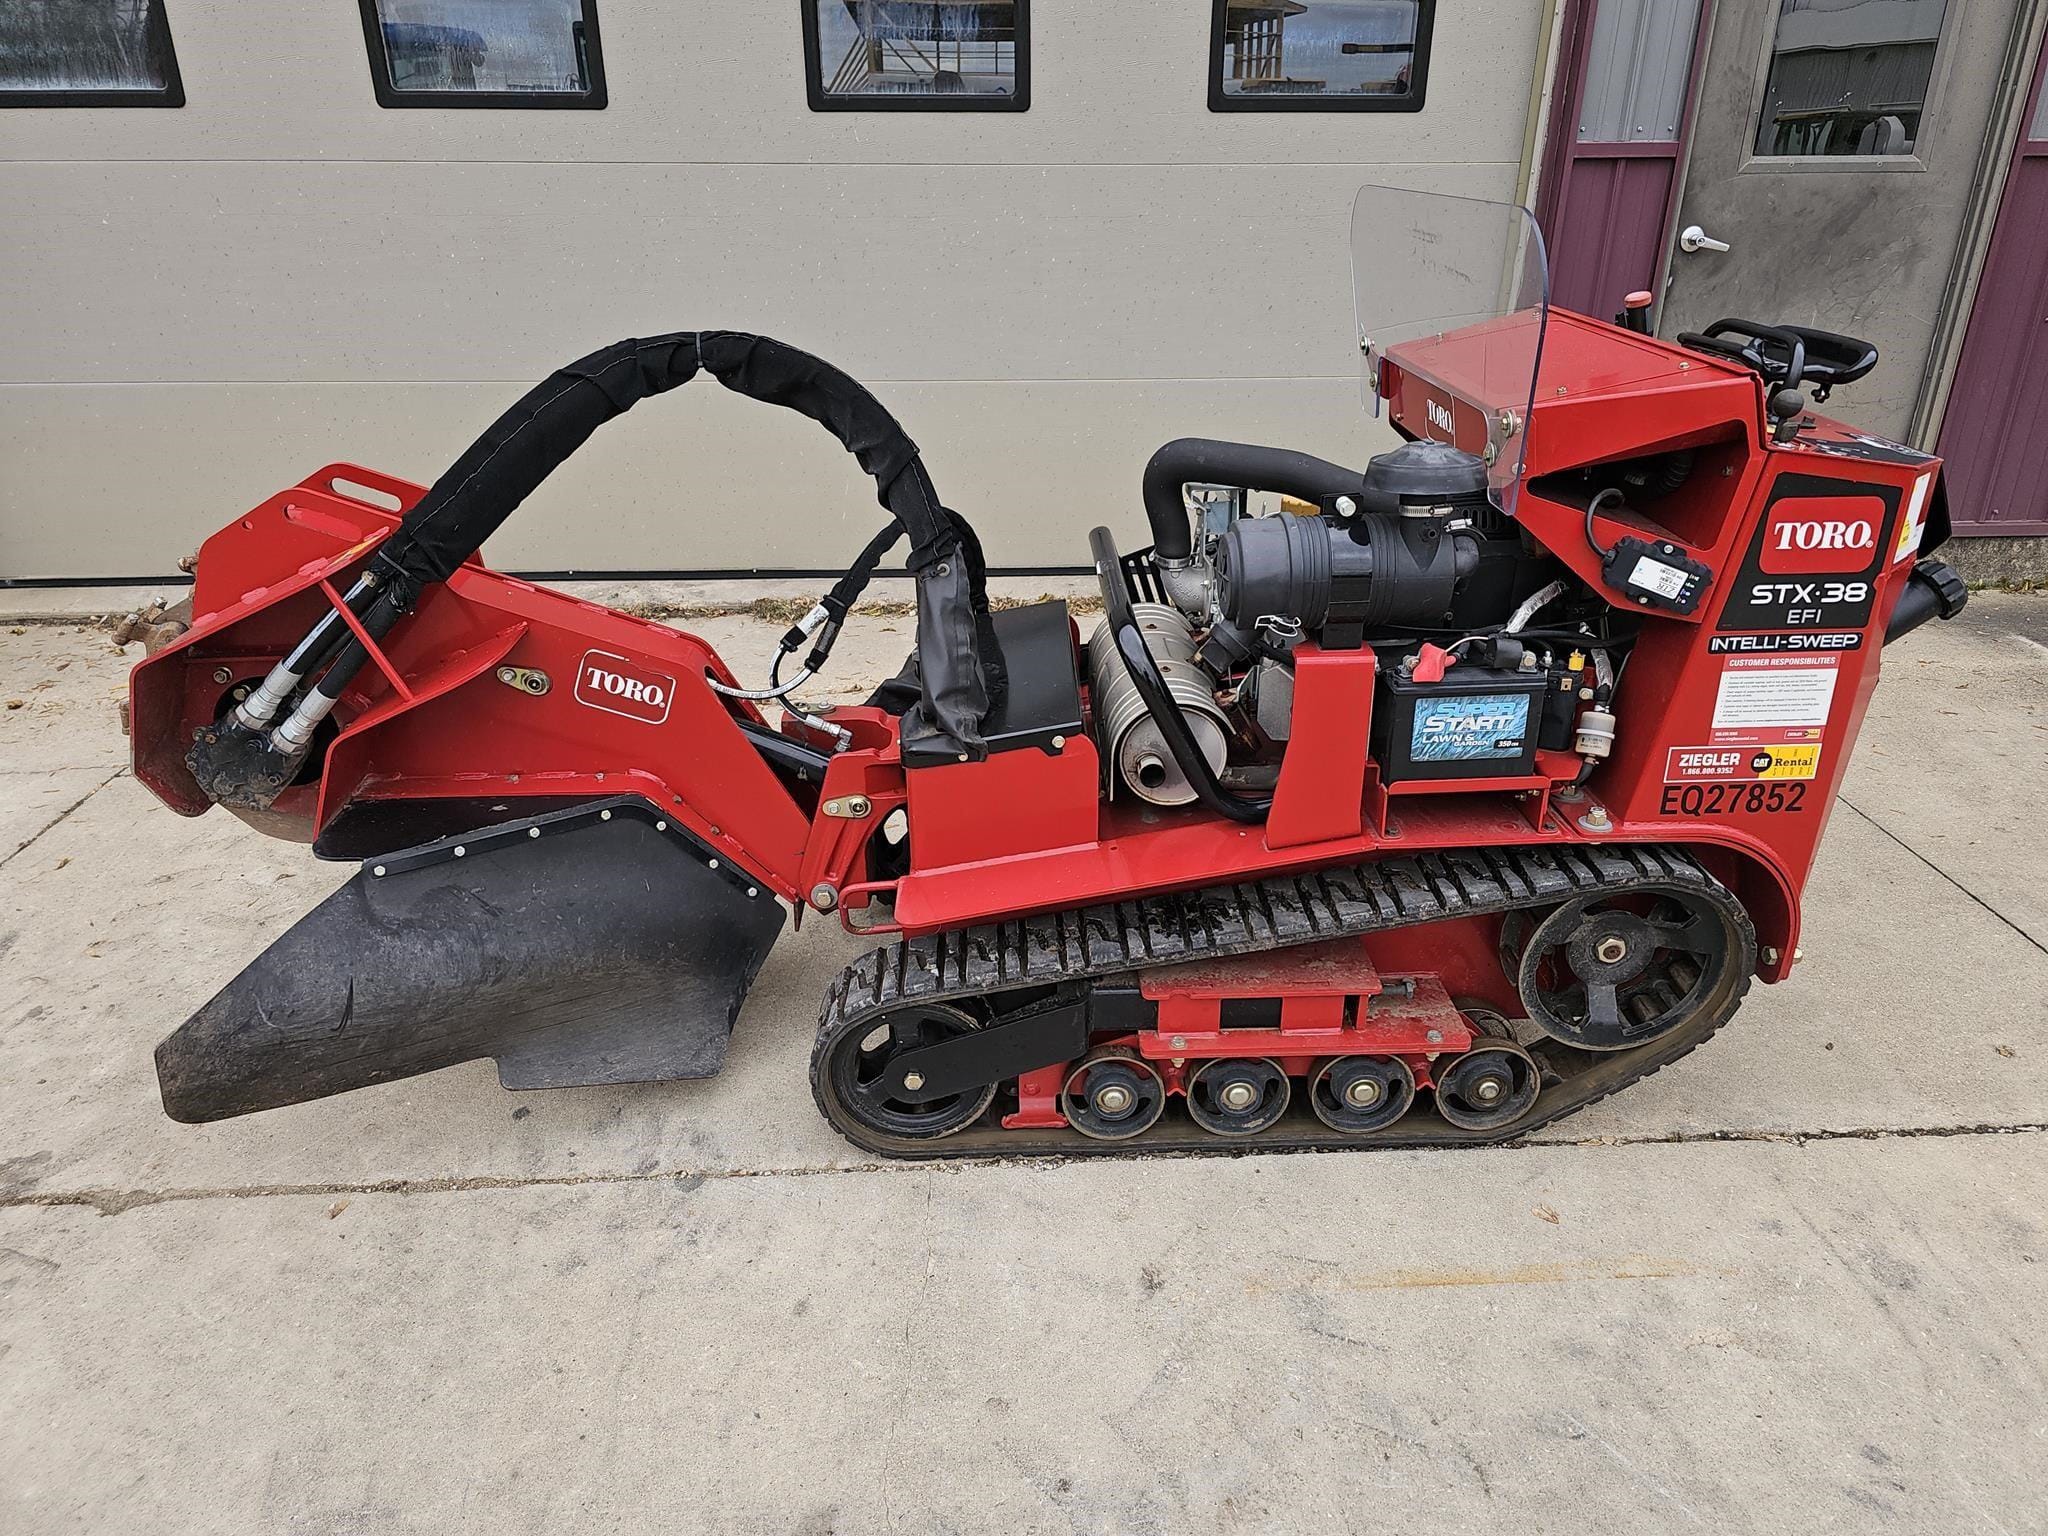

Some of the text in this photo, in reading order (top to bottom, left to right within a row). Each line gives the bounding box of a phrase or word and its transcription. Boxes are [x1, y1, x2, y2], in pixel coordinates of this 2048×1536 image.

[1427, 399, 1453, 433] TORO
[1774, 520, 1872, 550] TORO
[1787, 609, 1822, 624] EFI
[1711, 633, 1859, 651] INTELLI-SWEEP
[1729, 656, 1836, 667] CUSTOMER RESPONSIBILITIES
[587, 667, 664, 706] TORO
[1436, 702, 1516, 717] SUPER
[1422, 715, 1515, 733] START
[1422, 733, 1475, 743] LAWN &
[1679, 752, 1741, 767] ZIEGLER
[1753, 757, 1770, 768] CAT
[1774, 757, 1813, 767] Rental
[1660, 782, 1806, 816] EQ27852
